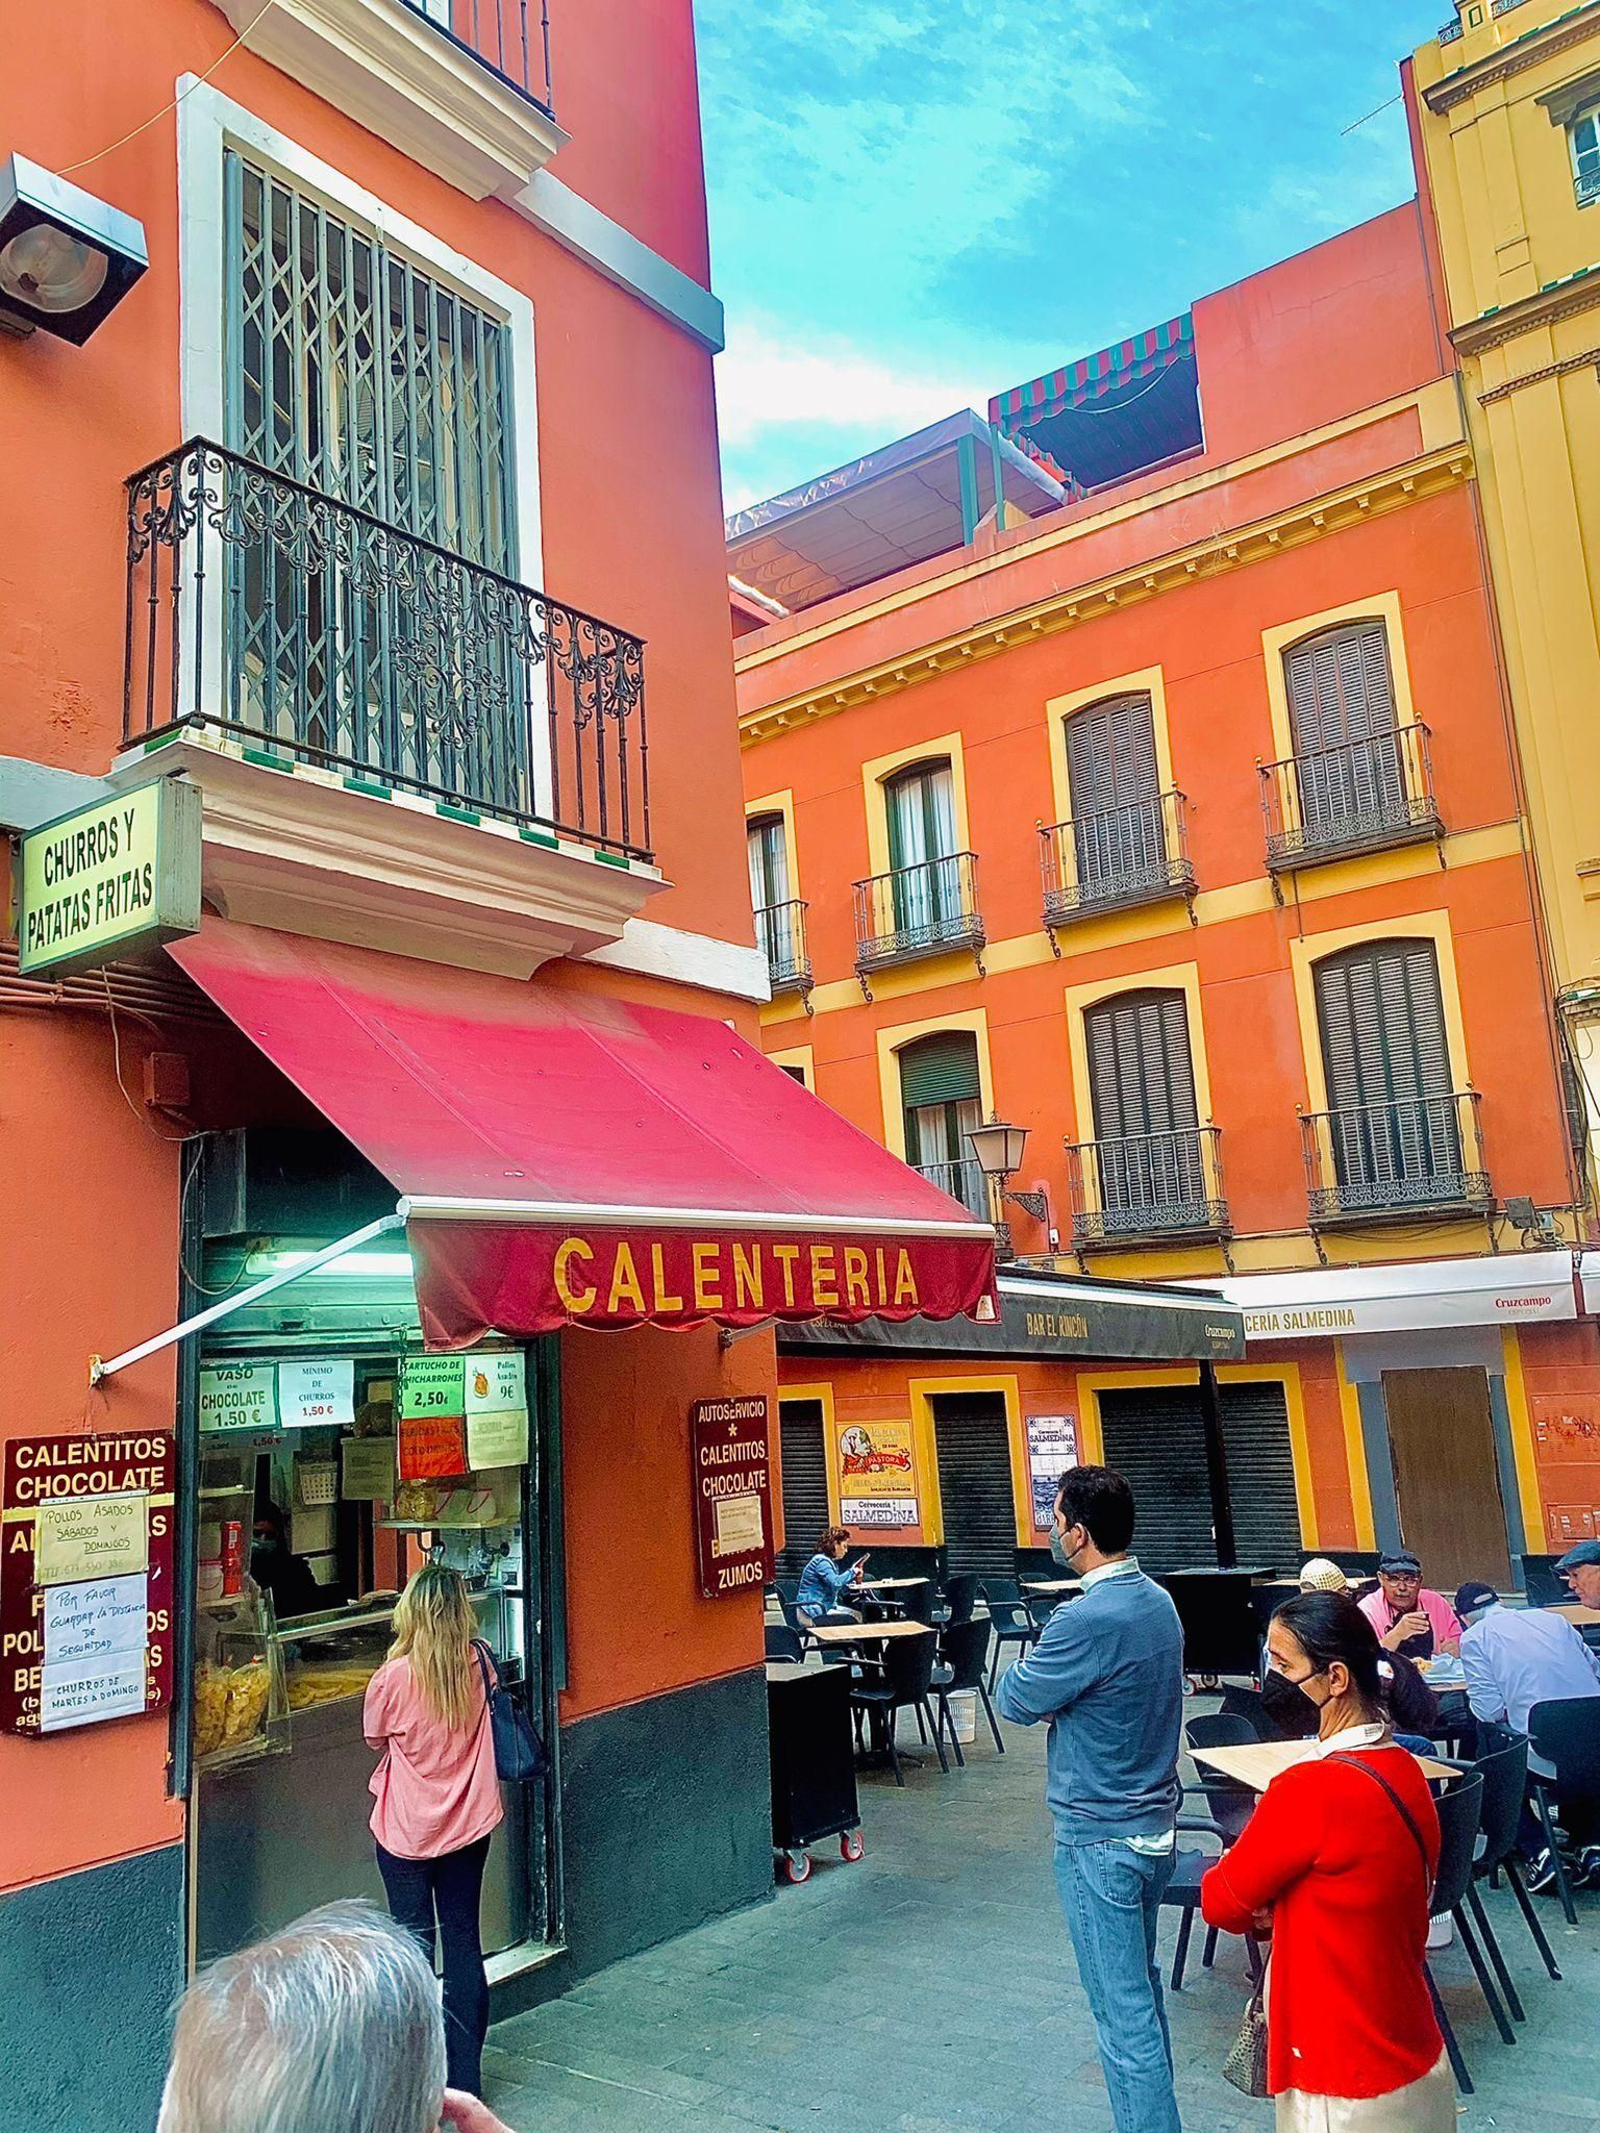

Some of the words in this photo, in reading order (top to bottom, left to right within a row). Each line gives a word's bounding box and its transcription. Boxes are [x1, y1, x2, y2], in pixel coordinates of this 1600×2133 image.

[44, 816, 119, 887] CHURROS
[124, 808, 135, 852] Y
[27, 888, 91, 953] PATATAS
[96, 862, 153, 925] FRITAS
[553, 1236, 920, 1314] CALENTERIA
[1495, 1296, 1552, 1309] Cruzcampo
[1026, 1312, 1046, 1336] BAR
[1046, 1313, 1058, 1337] EL
[1283, 1308, 1356, 1330] SALMEDINA
[216, 1368, 254, 1382] VASO
[449, 1361, 461, 1370] DE
[311, 1380, 323, 1388] DE
[403, 1373, 463, 1384] HICHARRONES
[201, 1390, 266, 1410] CHOCOLATE
[298, 1392, 336, 1402] CHURROS
[500, 1385, 515, 1399] 9€
[214, 1410, 247, 1428] 1.50
[251, 1409, 262, 1424] €
[302, 1406, 325, 1418] 1,50
[326, 1405, 334, 1415] €
[698, 1401, 765, 1424] AUTOSERVICIO
[15, 1437, 166, 1469] CALENTITOS
[700, 1439, 765, 1467] CALENTITOS
[867, 1456, 900, 1465] PASTORA
[15, 1466, 165, 1500] CHOCOLATE
[702, 1469, 767, 1497] CHOCOLATE
[45, 1509, 83, 1525] POLLOS
[93, 1504, 134, 1518] ASADOS
[83, 1537, 131, 1553] DOMINGOS
[718, 1560, 763, 1590] ZUMOS
[82, 1628, 96, 1638] DE
[56, 1677, 104, 1695] CHURROS
[108, 1676, 120, 1687] DE
[51, 1694, 88, 1709] MARTES
[91, 1694, 98, 1703] A
[100, 1685, 139, 1701] DOMINGO
